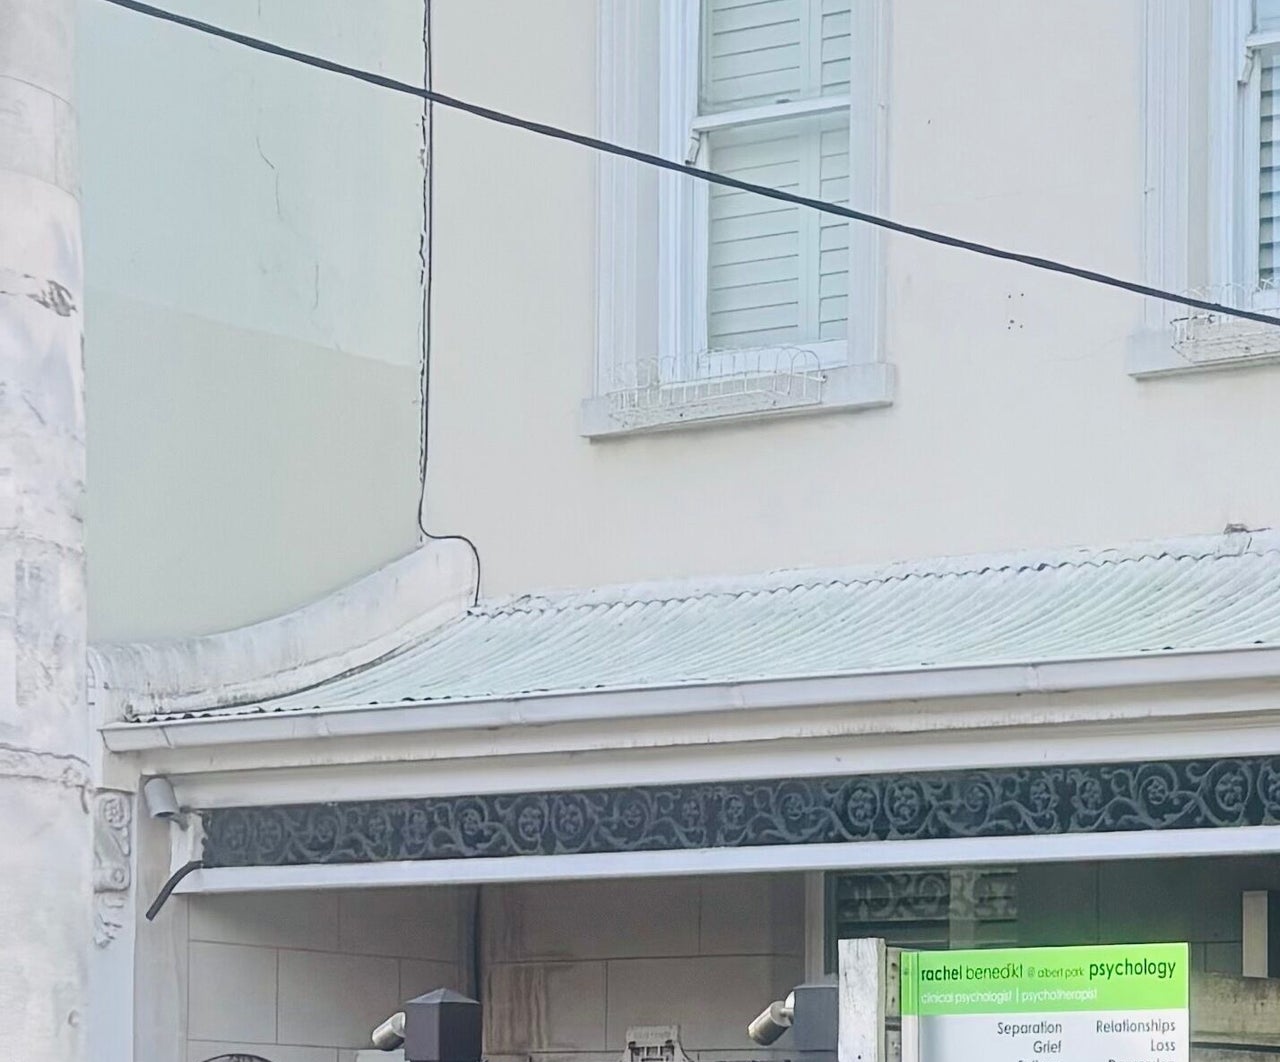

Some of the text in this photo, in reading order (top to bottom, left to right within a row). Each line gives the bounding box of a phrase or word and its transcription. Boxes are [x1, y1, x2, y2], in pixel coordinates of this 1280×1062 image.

[921, 965, 962, 981] rachel
[1089, 958, 1176, 980] psychology
[997, 1020, 1062, 1037] Separation
[1096, 1018, 1176, 1034] Relationships
[1033, 1040, 1062, 1053] Grief
[1150, 1038, 1176, 1052] Loss
